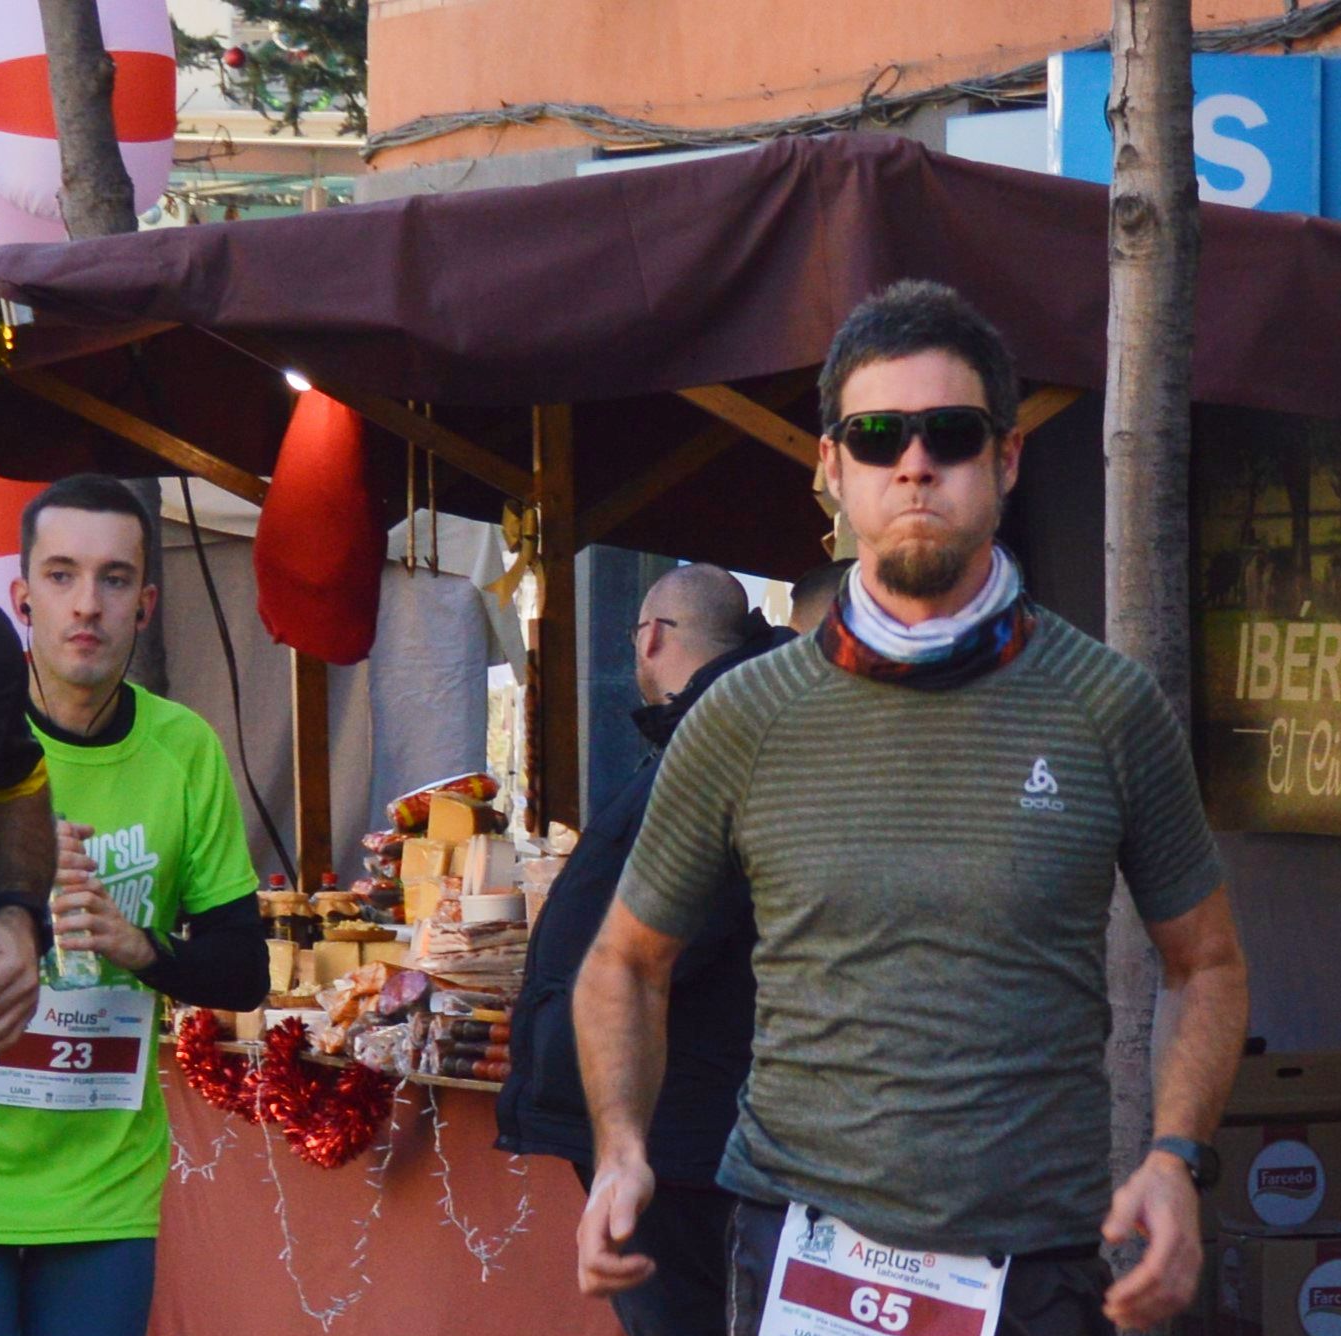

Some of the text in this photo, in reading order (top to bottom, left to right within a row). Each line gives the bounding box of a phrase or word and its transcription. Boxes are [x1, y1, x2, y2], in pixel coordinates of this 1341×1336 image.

[1267, 717, 1297, 795] El
[49, 1041, 93, 1070] 23
[1260, 1170, 1313, 1185] Farcedo
[876, 1267, 941, 1292] laboratories
[849, 1286, 913, 1333] 65
